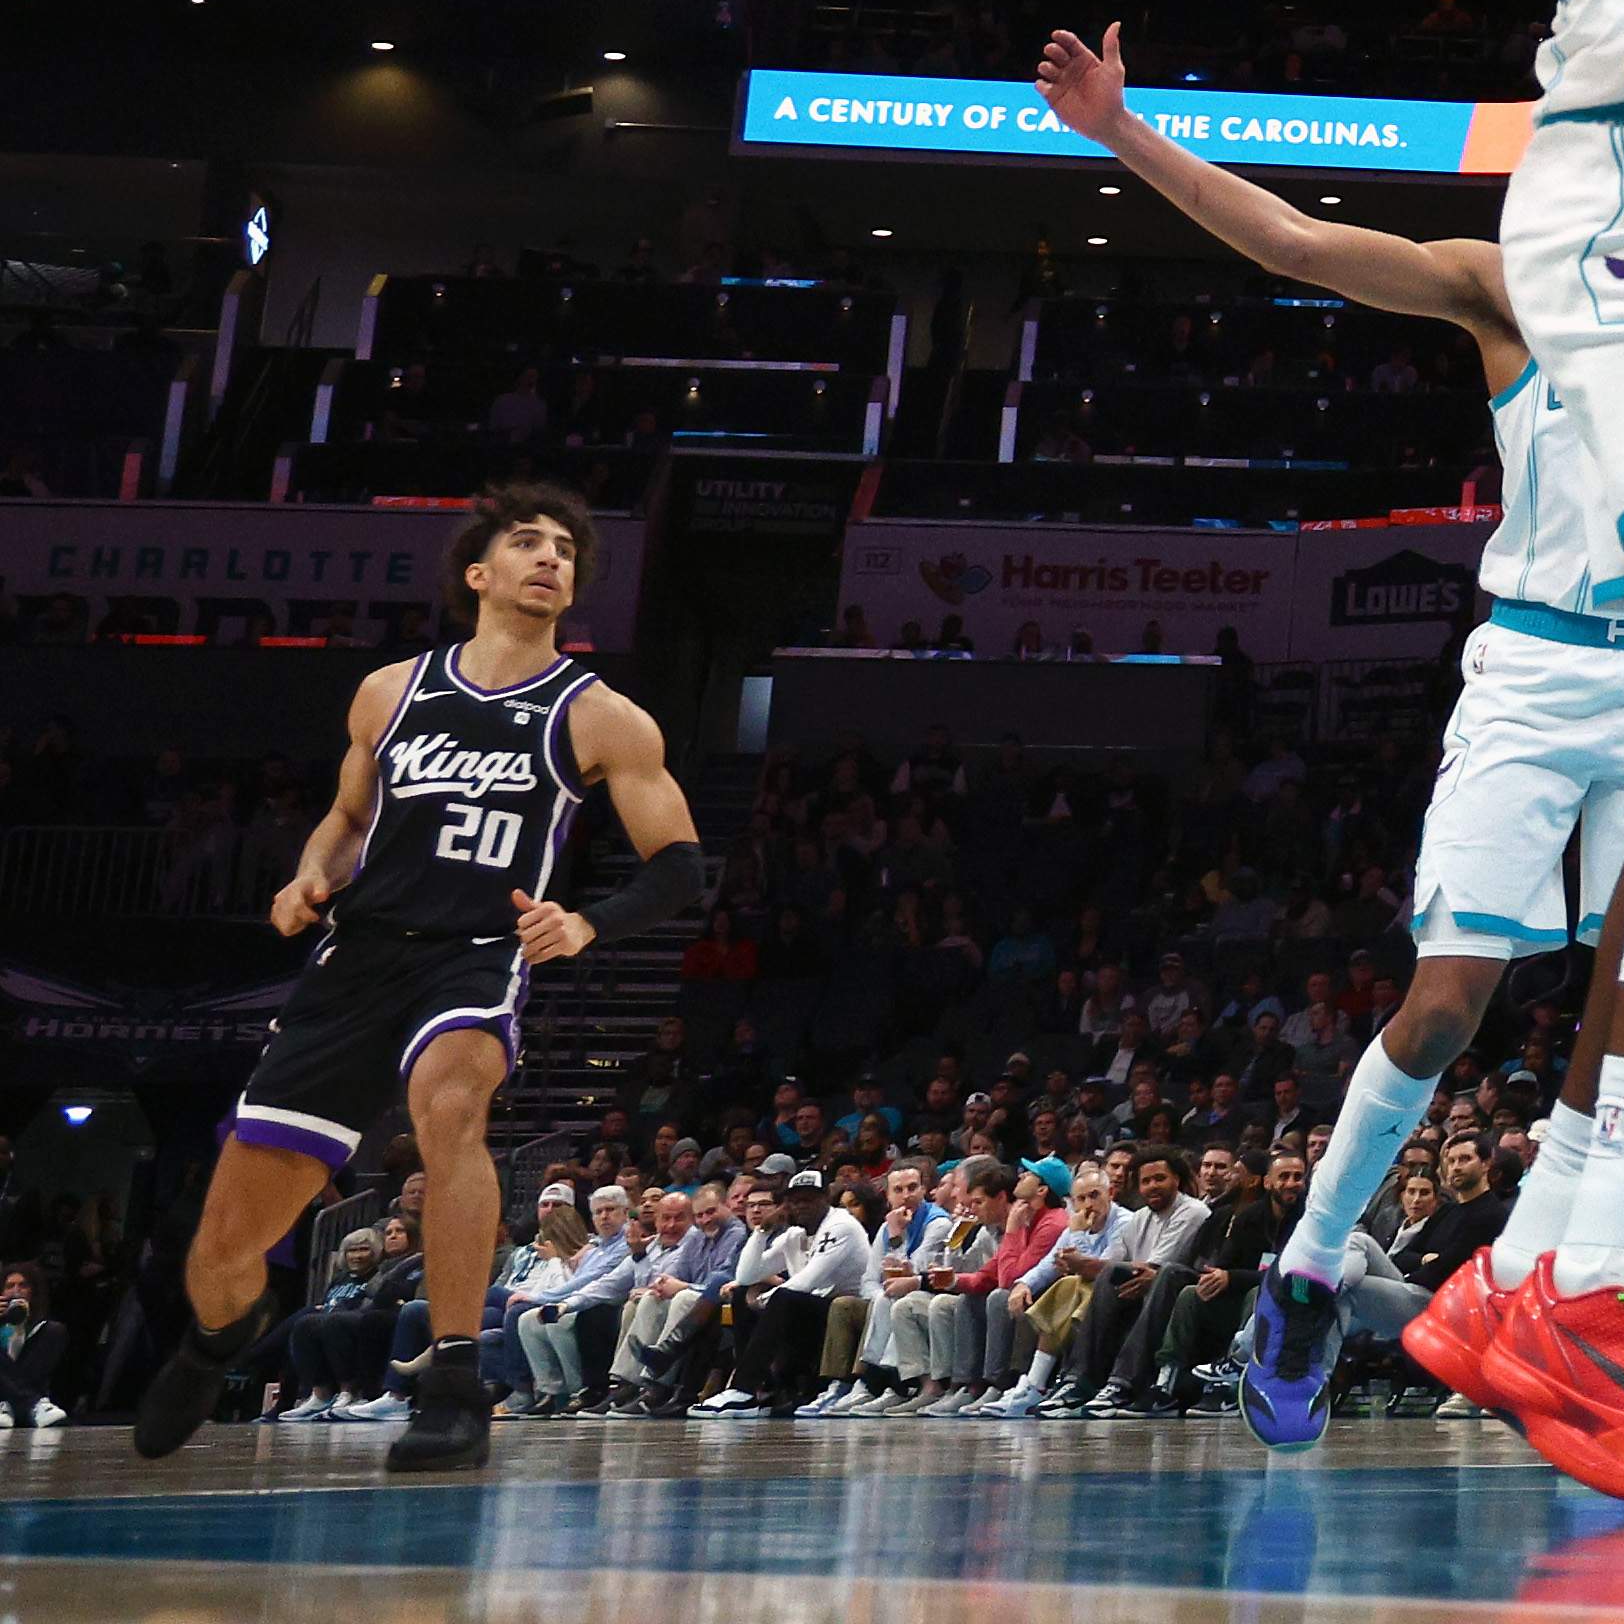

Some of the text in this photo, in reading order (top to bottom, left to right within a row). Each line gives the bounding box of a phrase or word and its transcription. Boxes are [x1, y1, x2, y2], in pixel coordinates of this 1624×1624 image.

[774, 96, 1408, 149] A CENTURY OF THE CAROLINAS.
[697, 480, 787, 498] UTILITY
[49, 546, 412, 584] CHARLOTTE
[1003, 554, 1270, 595] Harris Teeter
[1345, 580, 1464, 617] LOWE'S
[389, 732, 537, 799] Kings
[436, 803, 523, 869] 20
